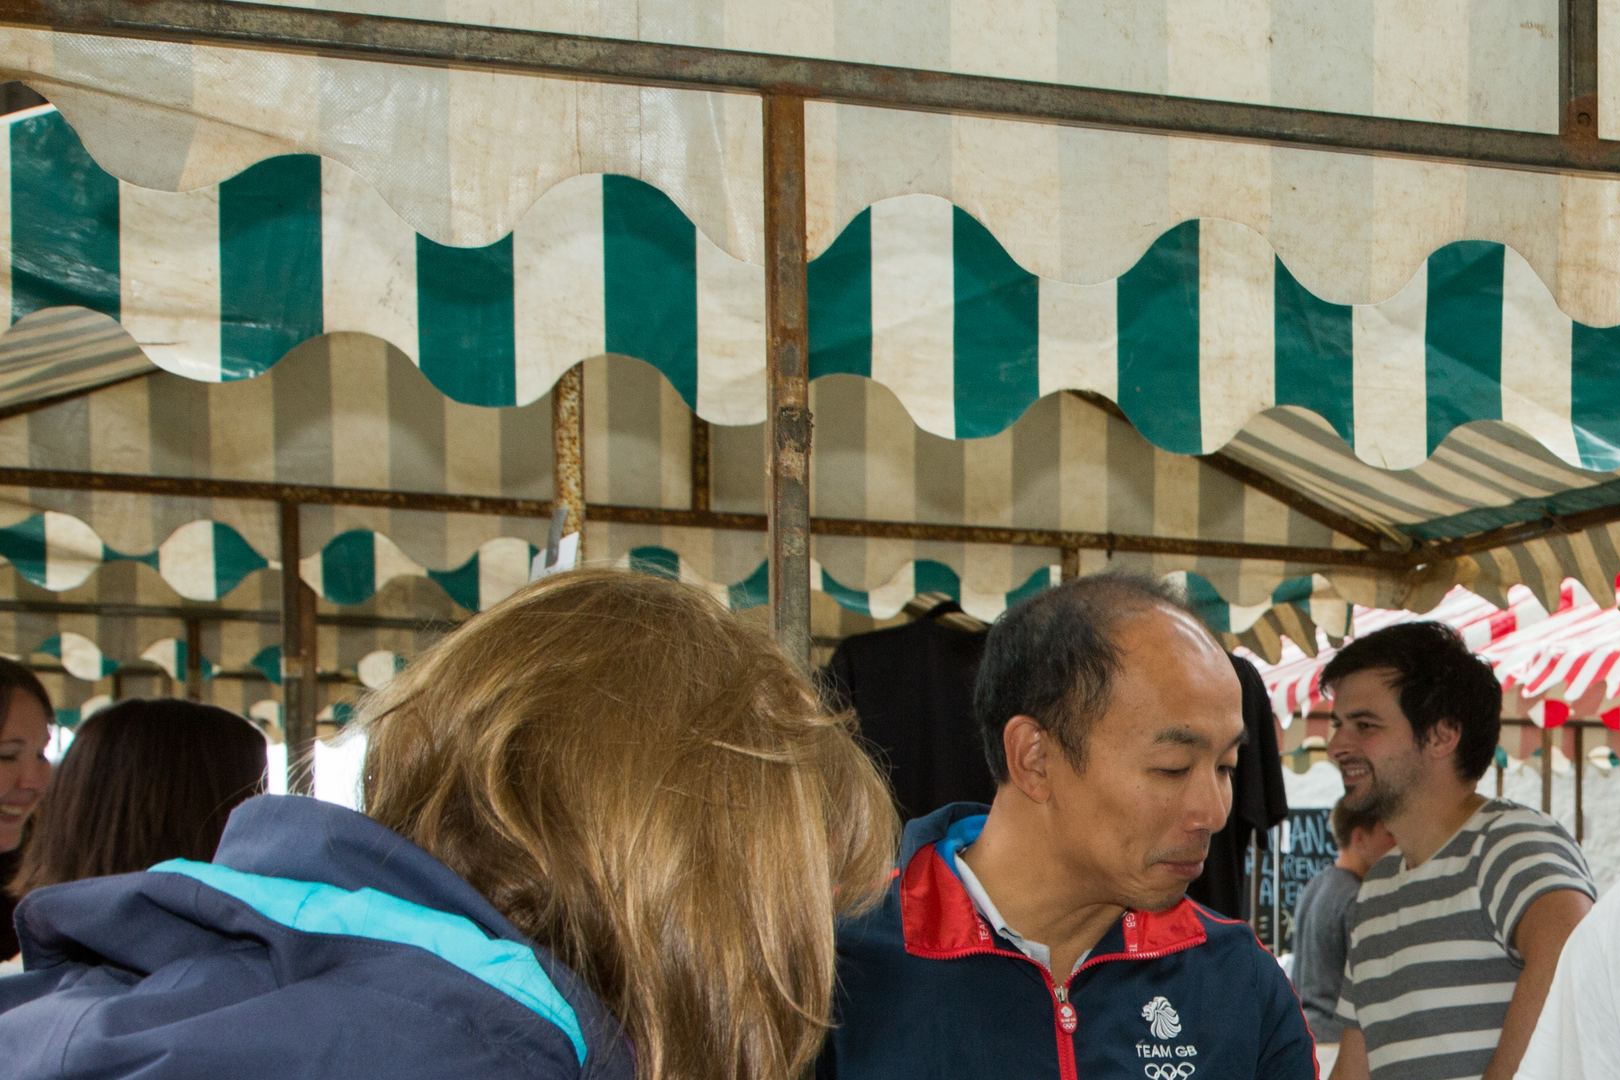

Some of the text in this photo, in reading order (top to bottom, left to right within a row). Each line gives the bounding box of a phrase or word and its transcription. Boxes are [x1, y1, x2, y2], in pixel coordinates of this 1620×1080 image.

[1126, 913, 1136, 928] GB
[1135, 1044, 1197, 1058] TEAM GB
